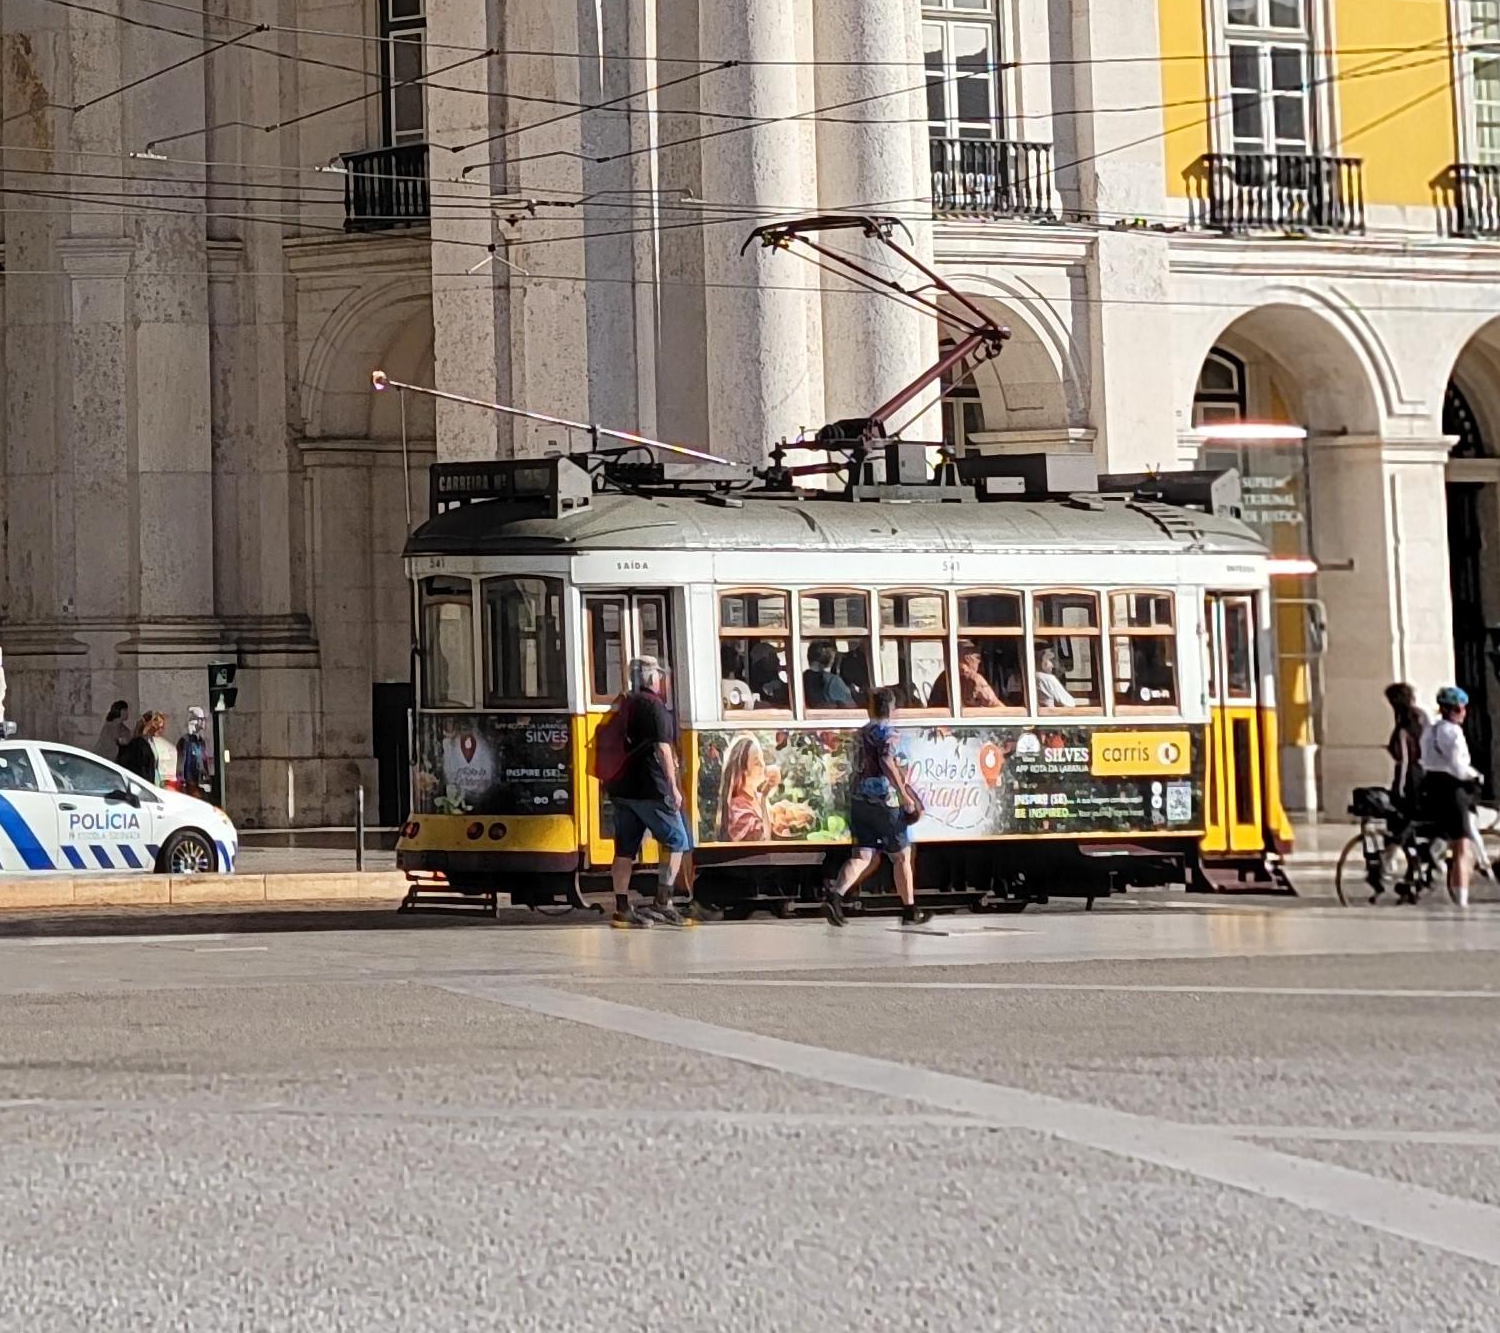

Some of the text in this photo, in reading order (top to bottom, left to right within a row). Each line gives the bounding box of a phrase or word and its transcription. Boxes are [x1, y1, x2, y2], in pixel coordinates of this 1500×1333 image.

[439, 474, 489, 492] CARREIRA
[616, 559, 649, 570] SAÍDA
[525, 730, 569, 743] SILVES
[1044, 747, 1089, 763] SILVES
[1102, 741, 1150, 763] carris
[925, 758, 976, 781] Rota da
[70, 809, 140, 829] POLÍCIA
